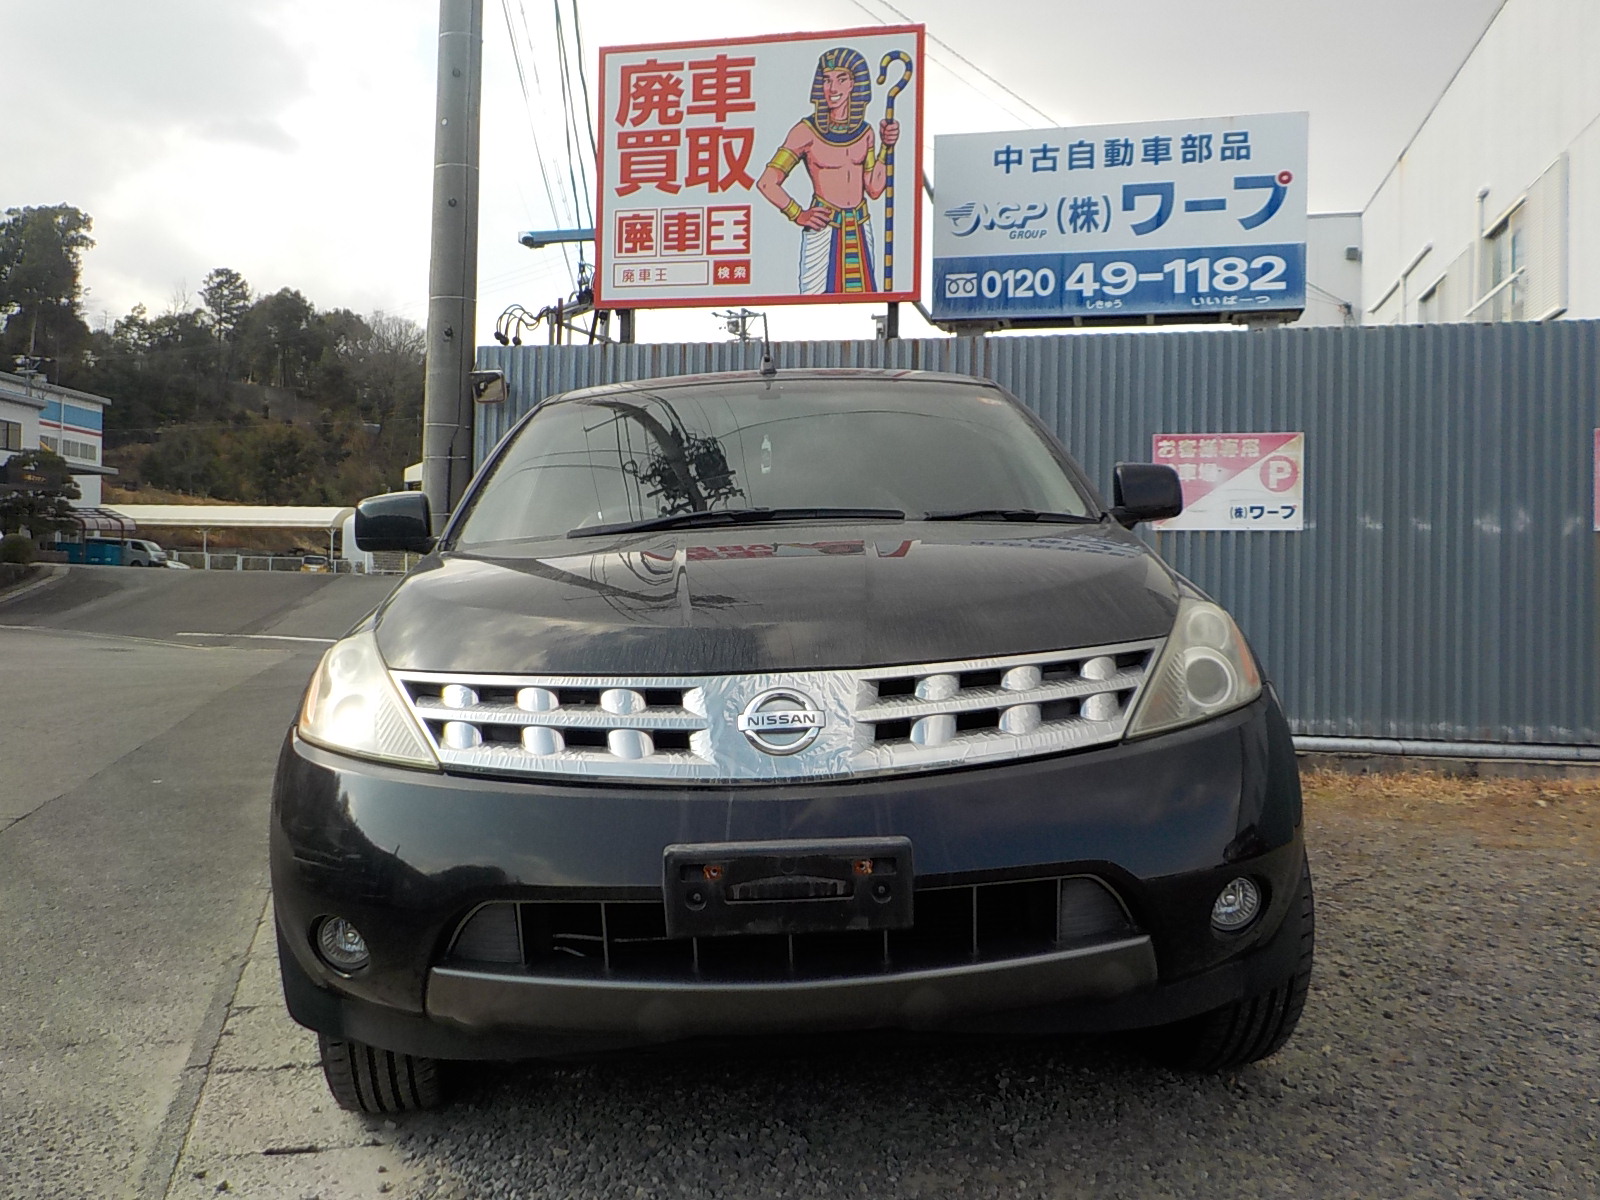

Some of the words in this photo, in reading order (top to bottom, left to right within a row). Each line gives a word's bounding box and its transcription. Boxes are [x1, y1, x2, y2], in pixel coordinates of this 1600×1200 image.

[615, 54, 756, 127] 廃車
[614, 126, 755, 197] 買取
[993, 130, 1251, 175] 中古自動車部品
[1009, 229, 1048, 240] GROUP
[621, 267, 668, 284] 廃車王
[717, 265, 747, 280] 検索
[981, 267, 1056, 299] 0120
[1064, 255, 1287, 297] 49-1182
[747, 713, 816, 727] NISSAN
